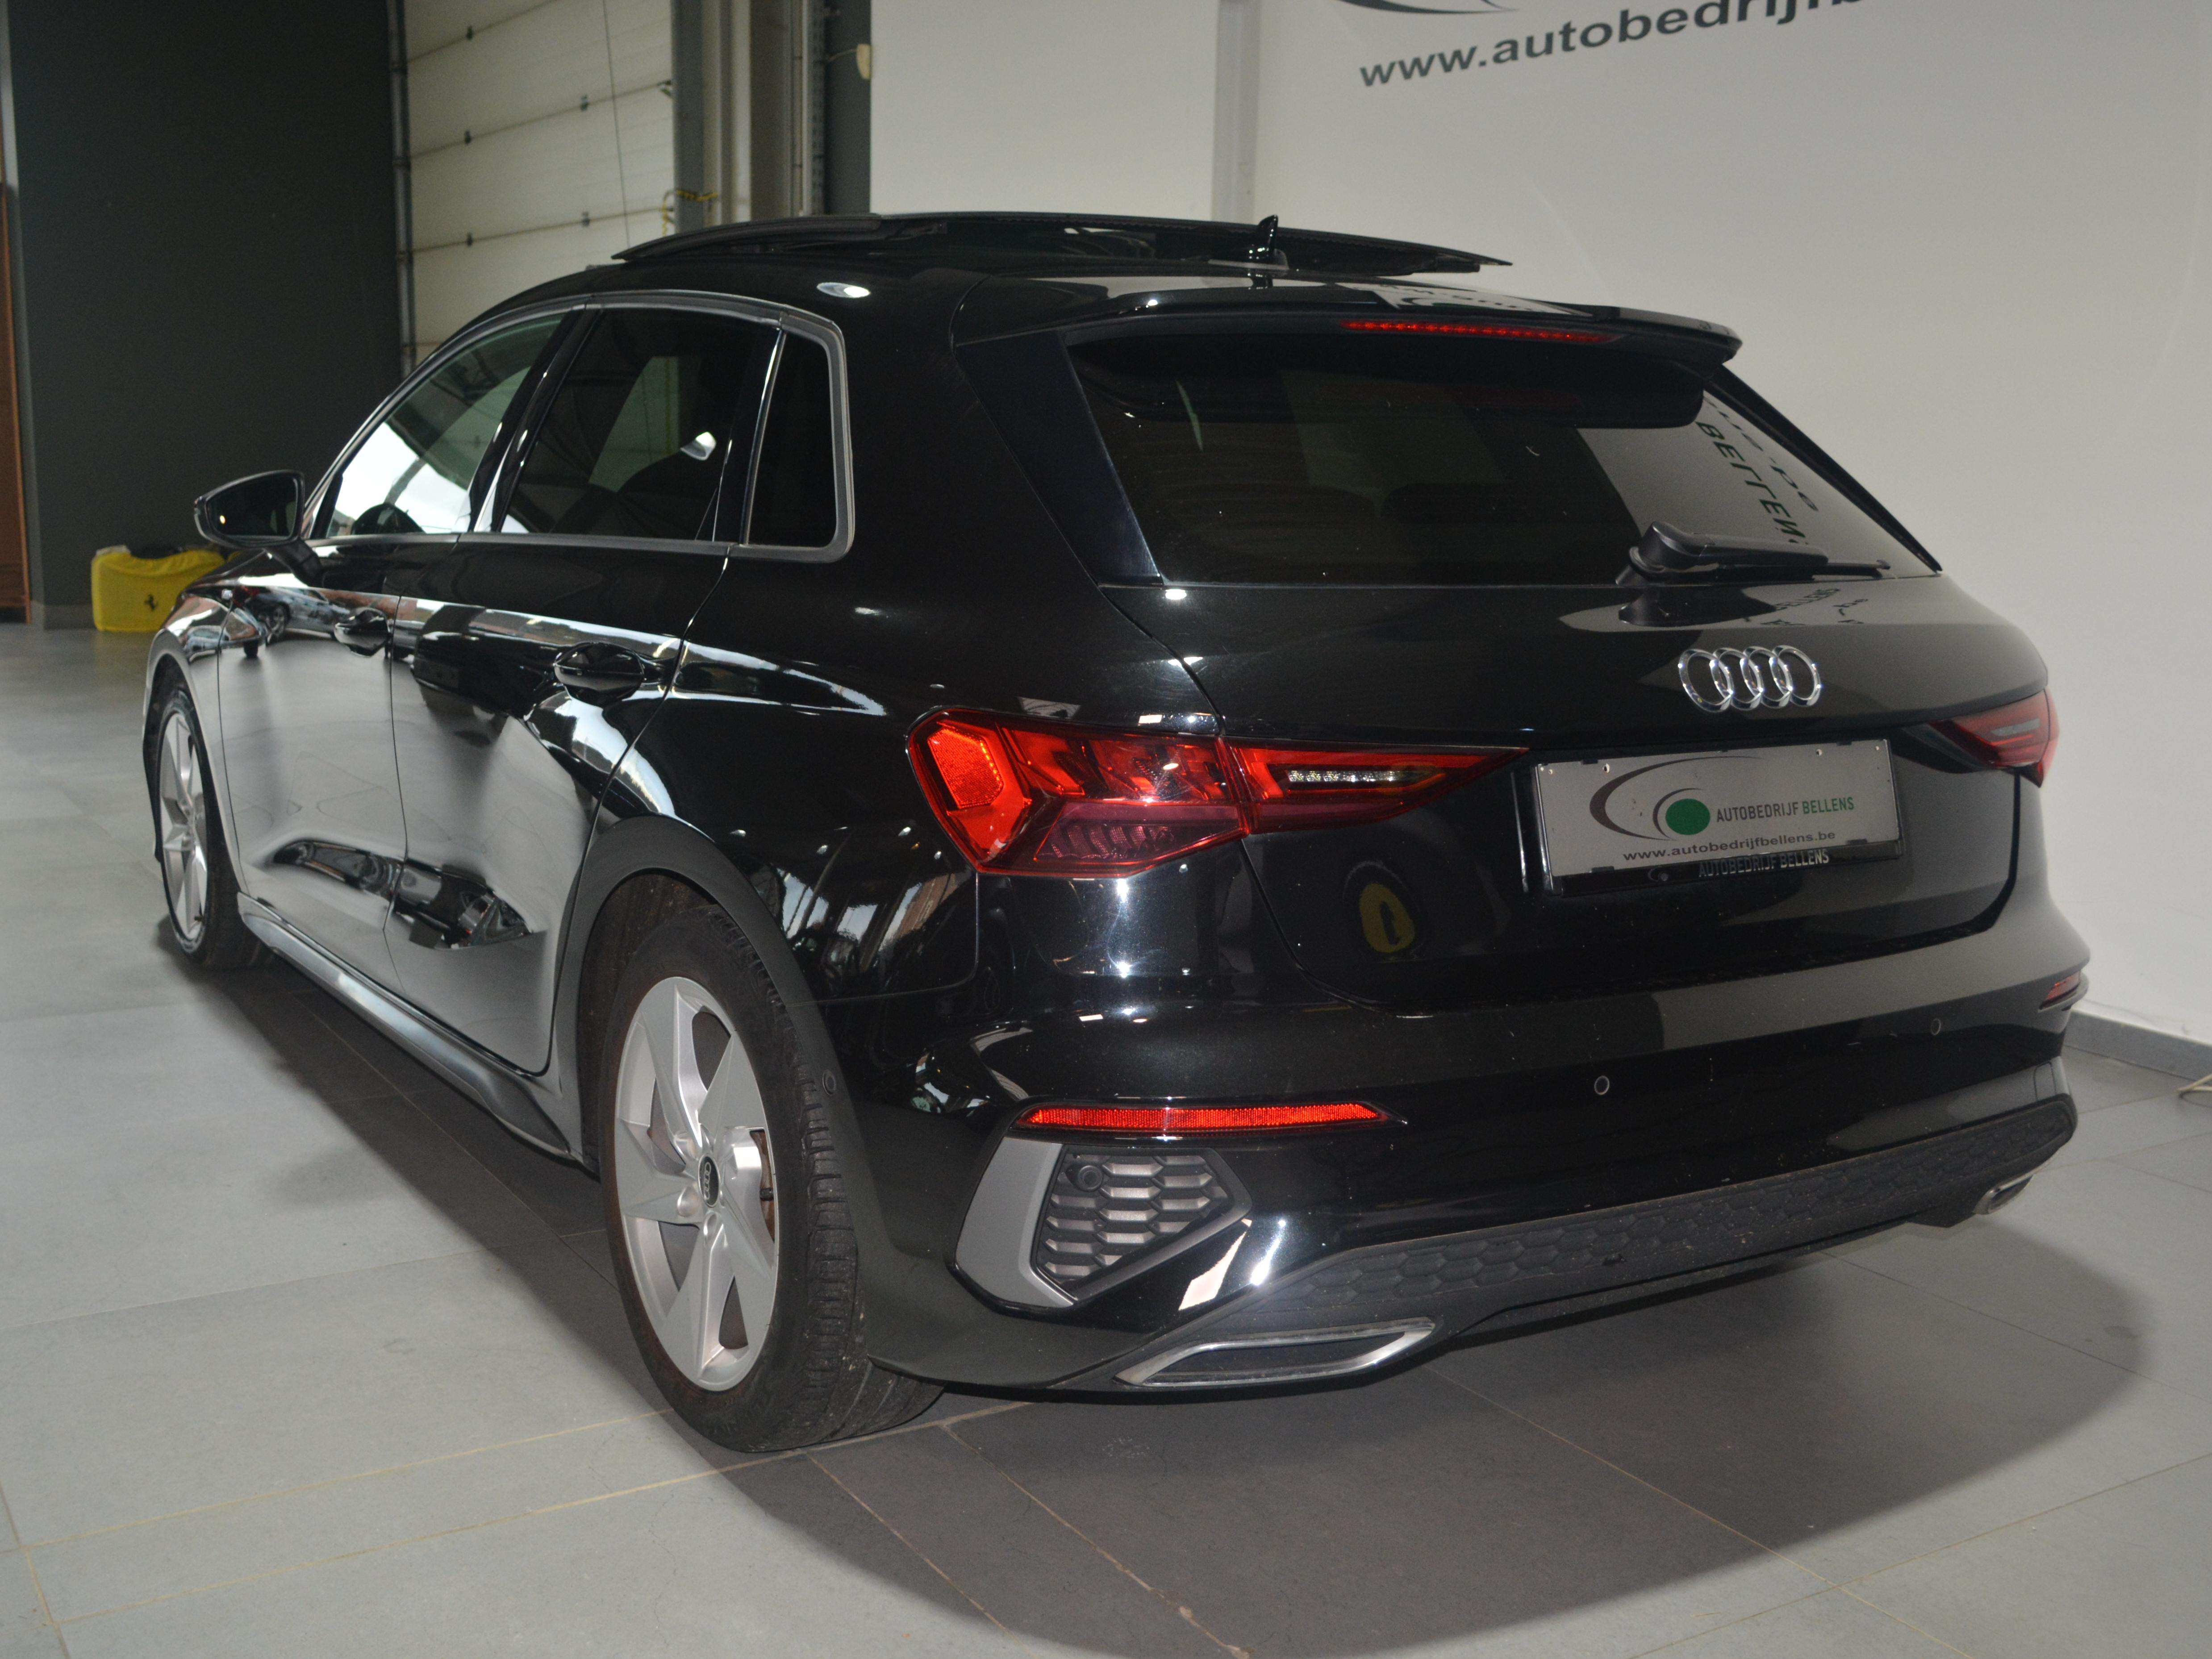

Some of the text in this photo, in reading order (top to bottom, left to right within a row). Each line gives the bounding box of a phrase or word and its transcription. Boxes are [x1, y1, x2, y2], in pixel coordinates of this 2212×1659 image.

[1360, 0, 1862, 86] www.autobedrj
[1716, 797, 1855, 822] AUTOBEDRIJF BELLENS
[1623, 831, 1835, 861] www.autobedrijfbellens.be
[1699, 848, 1829, 878] AUTOBEDRIJF BELLENS
